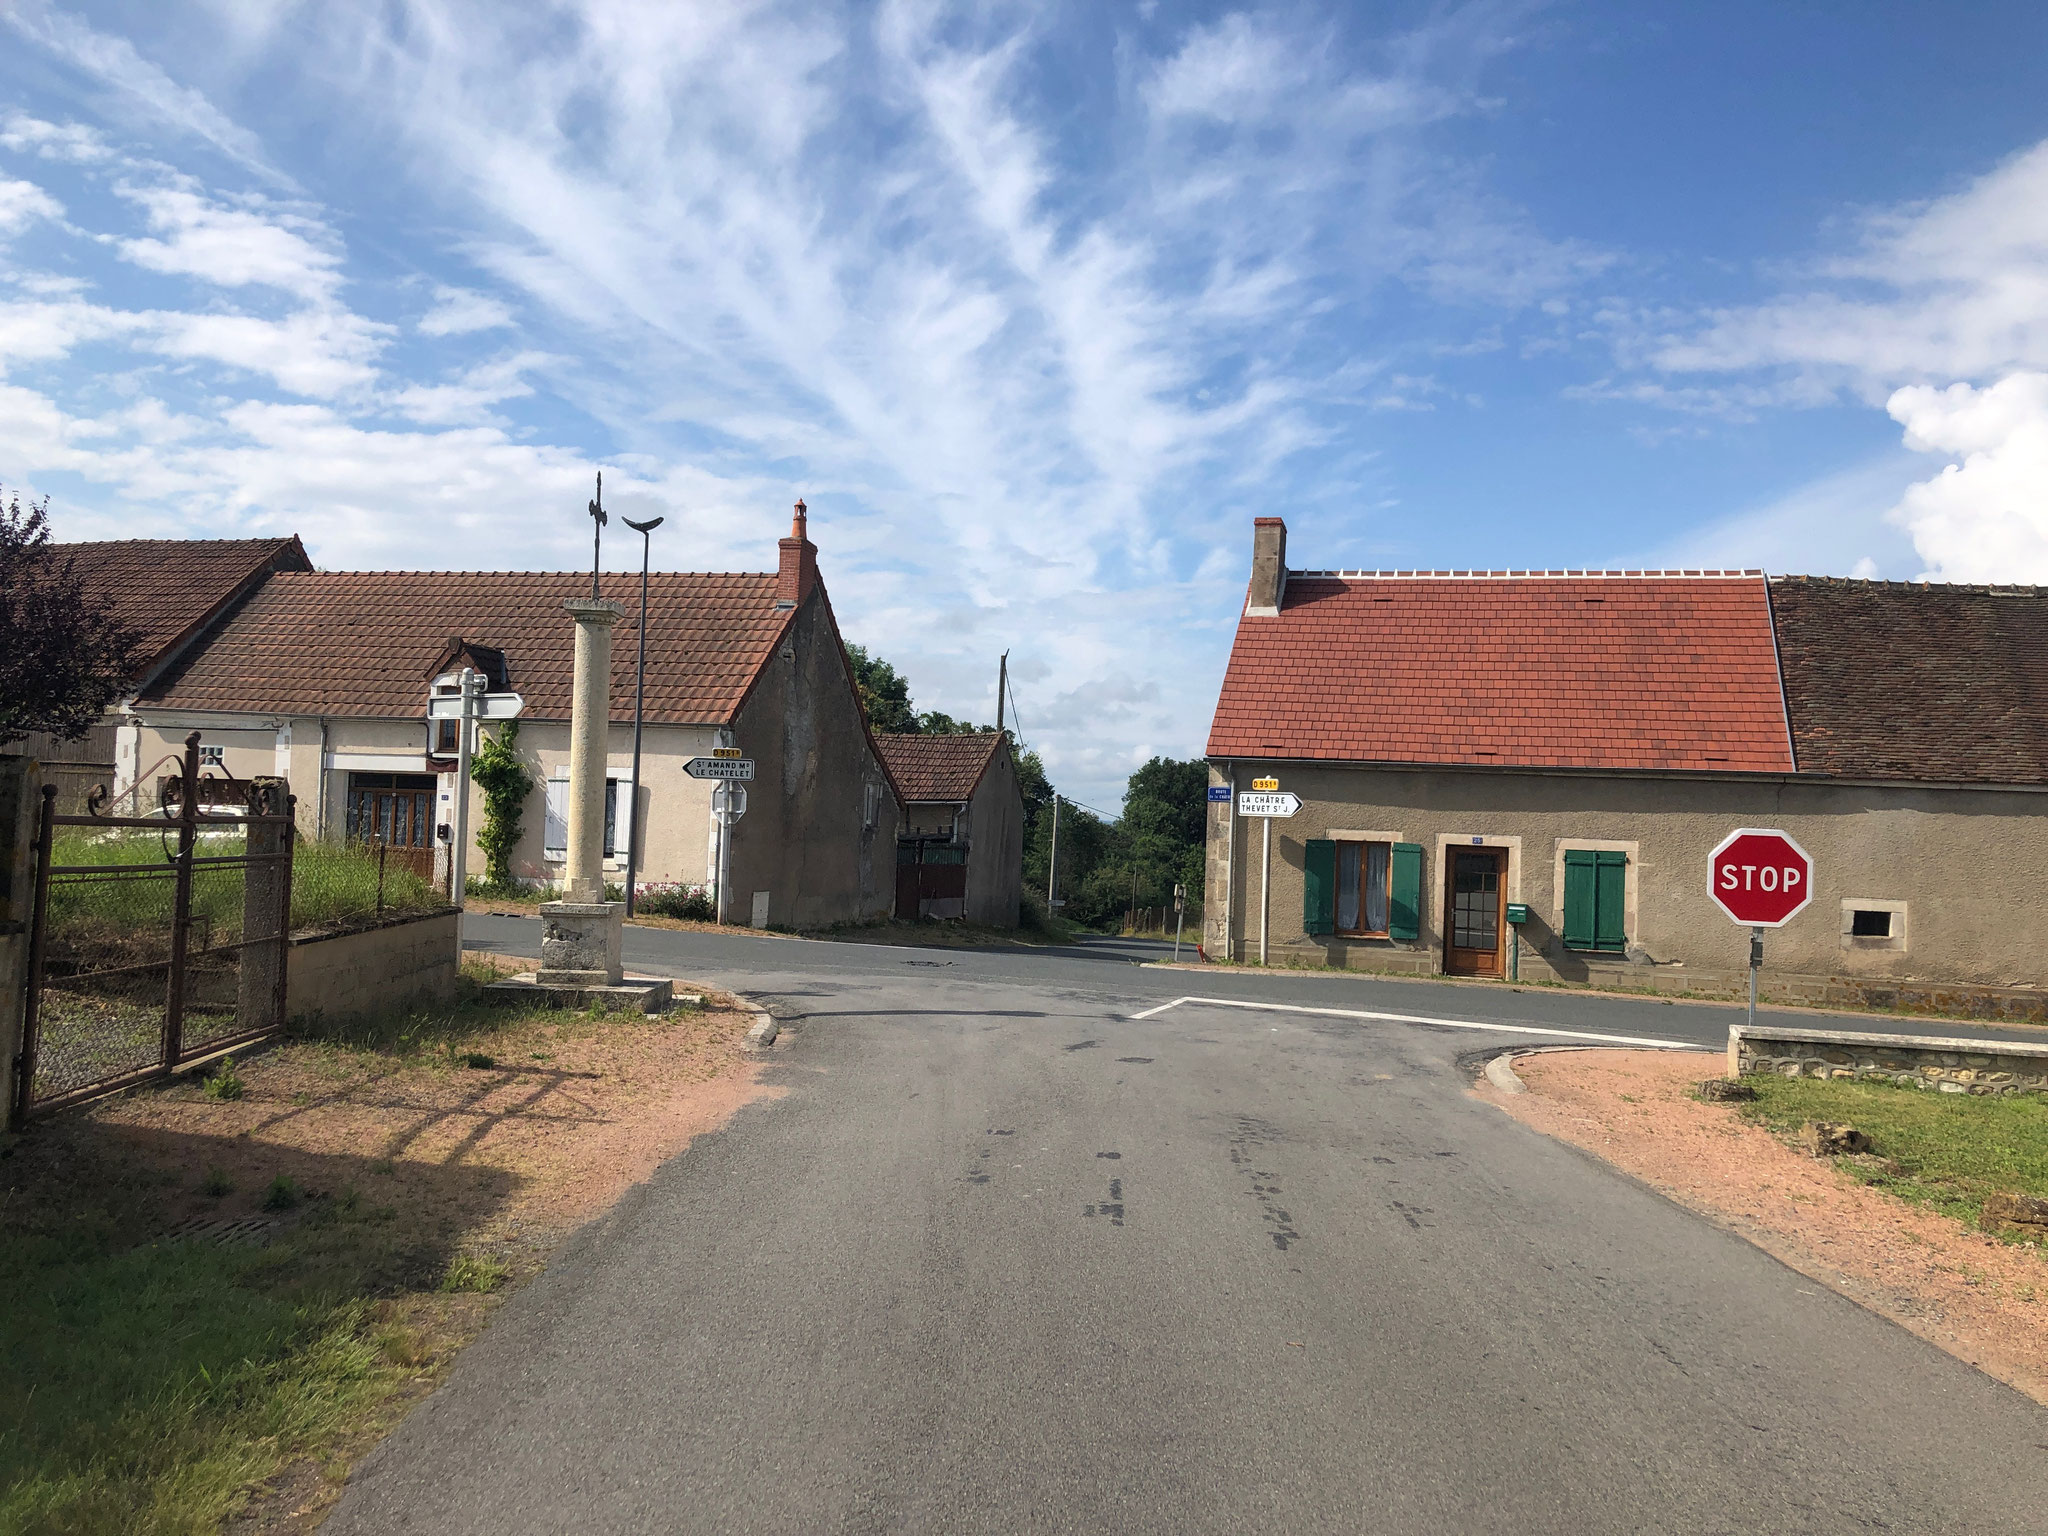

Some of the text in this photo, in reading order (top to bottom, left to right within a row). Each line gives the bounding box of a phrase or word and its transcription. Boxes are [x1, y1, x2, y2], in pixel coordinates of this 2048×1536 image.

[1253, 780, 1258, 788] D
[1254, 795, 1285, 804] CHÂTRE
[1241, 804, 1270, 812] THEVET
[1720, 864, 1801, 893] STOP
